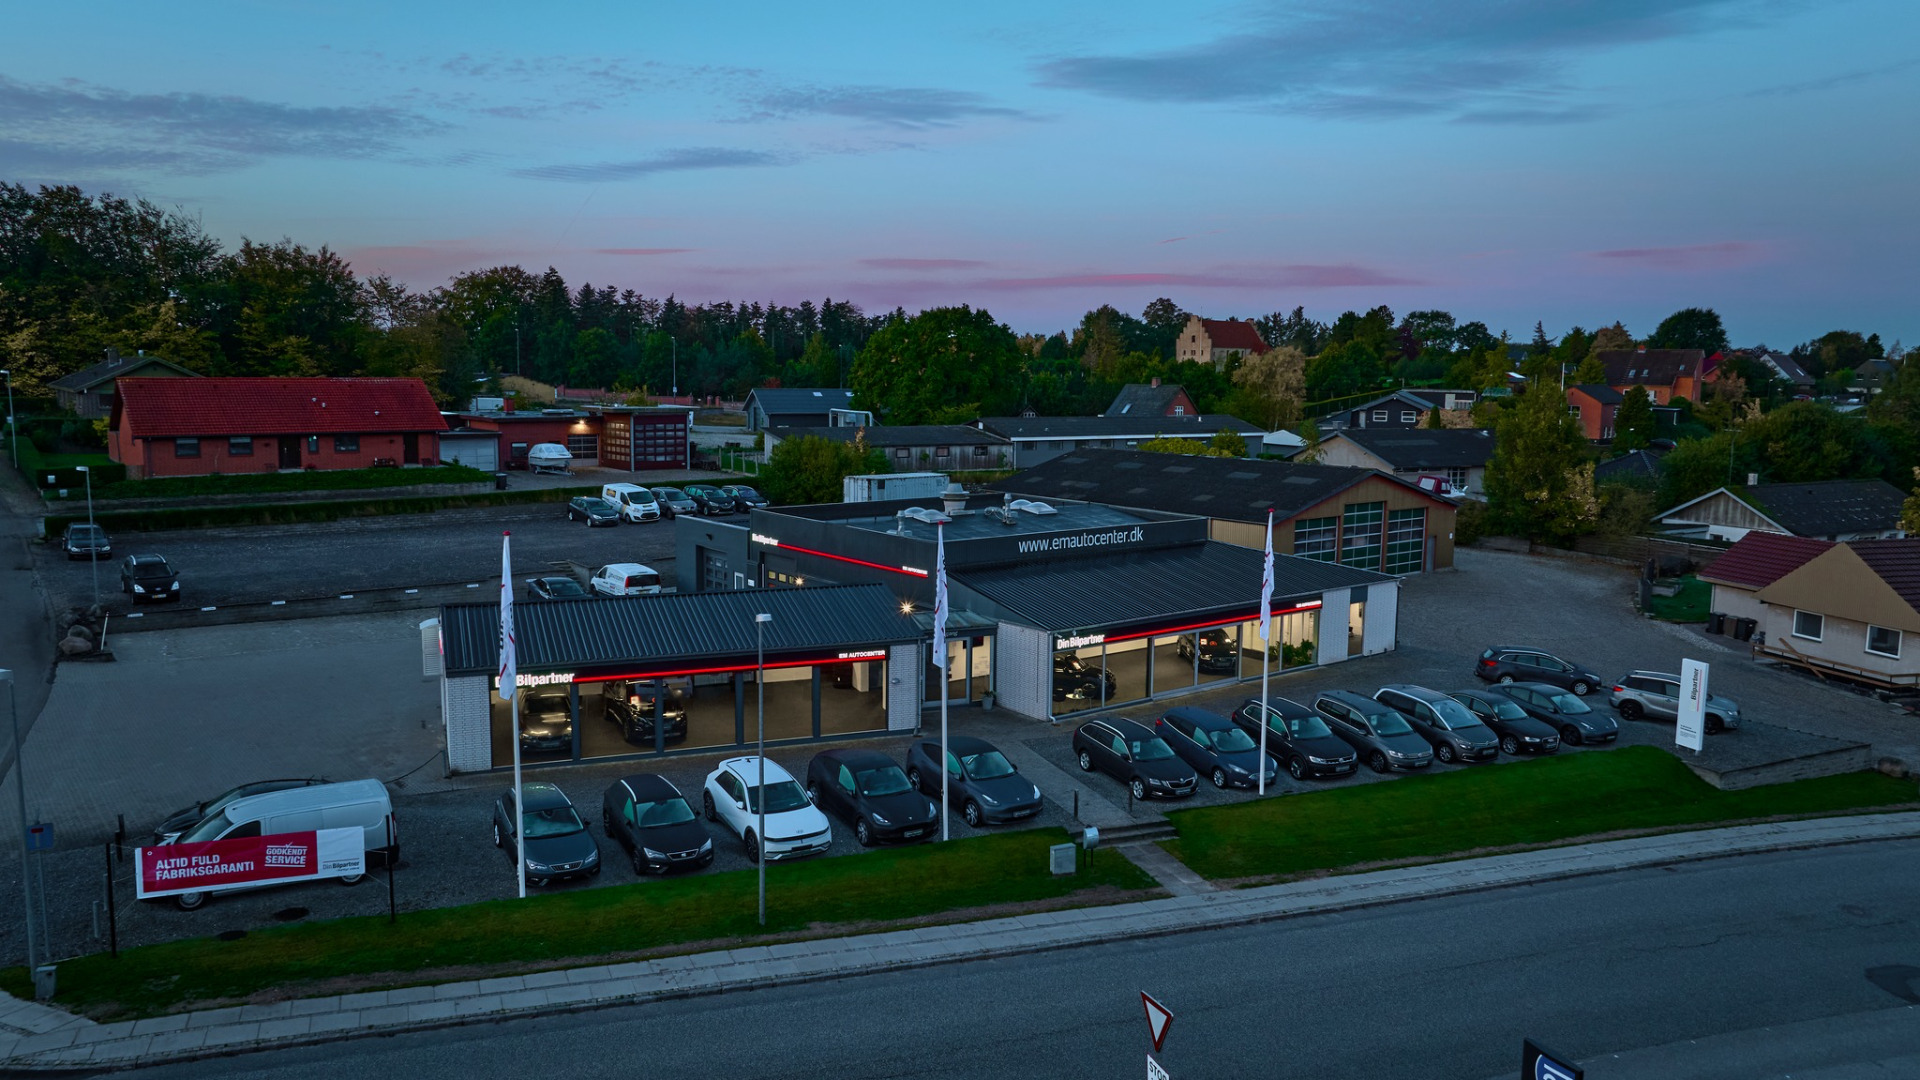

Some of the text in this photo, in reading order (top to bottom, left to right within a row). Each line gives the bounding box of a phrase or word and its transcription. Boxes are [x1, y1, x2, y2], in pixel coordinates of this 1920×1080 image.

[1018, 526, 1144, 553] www.emautocenter.dk
[1057, 634, 1105, 649] Din Bilpartner
[848, 649, 886, 658] AUTOCENTER
[515, 672, 575, 687] Bilpartner
[1690, 668, 1699, 700] Bilpartner
[265, 848, 308, 856] GODKENDT
[156, 854, 220, 870] ALTID FULD
[264, 855, 307, 865] SERVICE
[332, 861, 360, 869] Bilpartner
[156, 861, 255, 881] FABRIKSGARANTI
